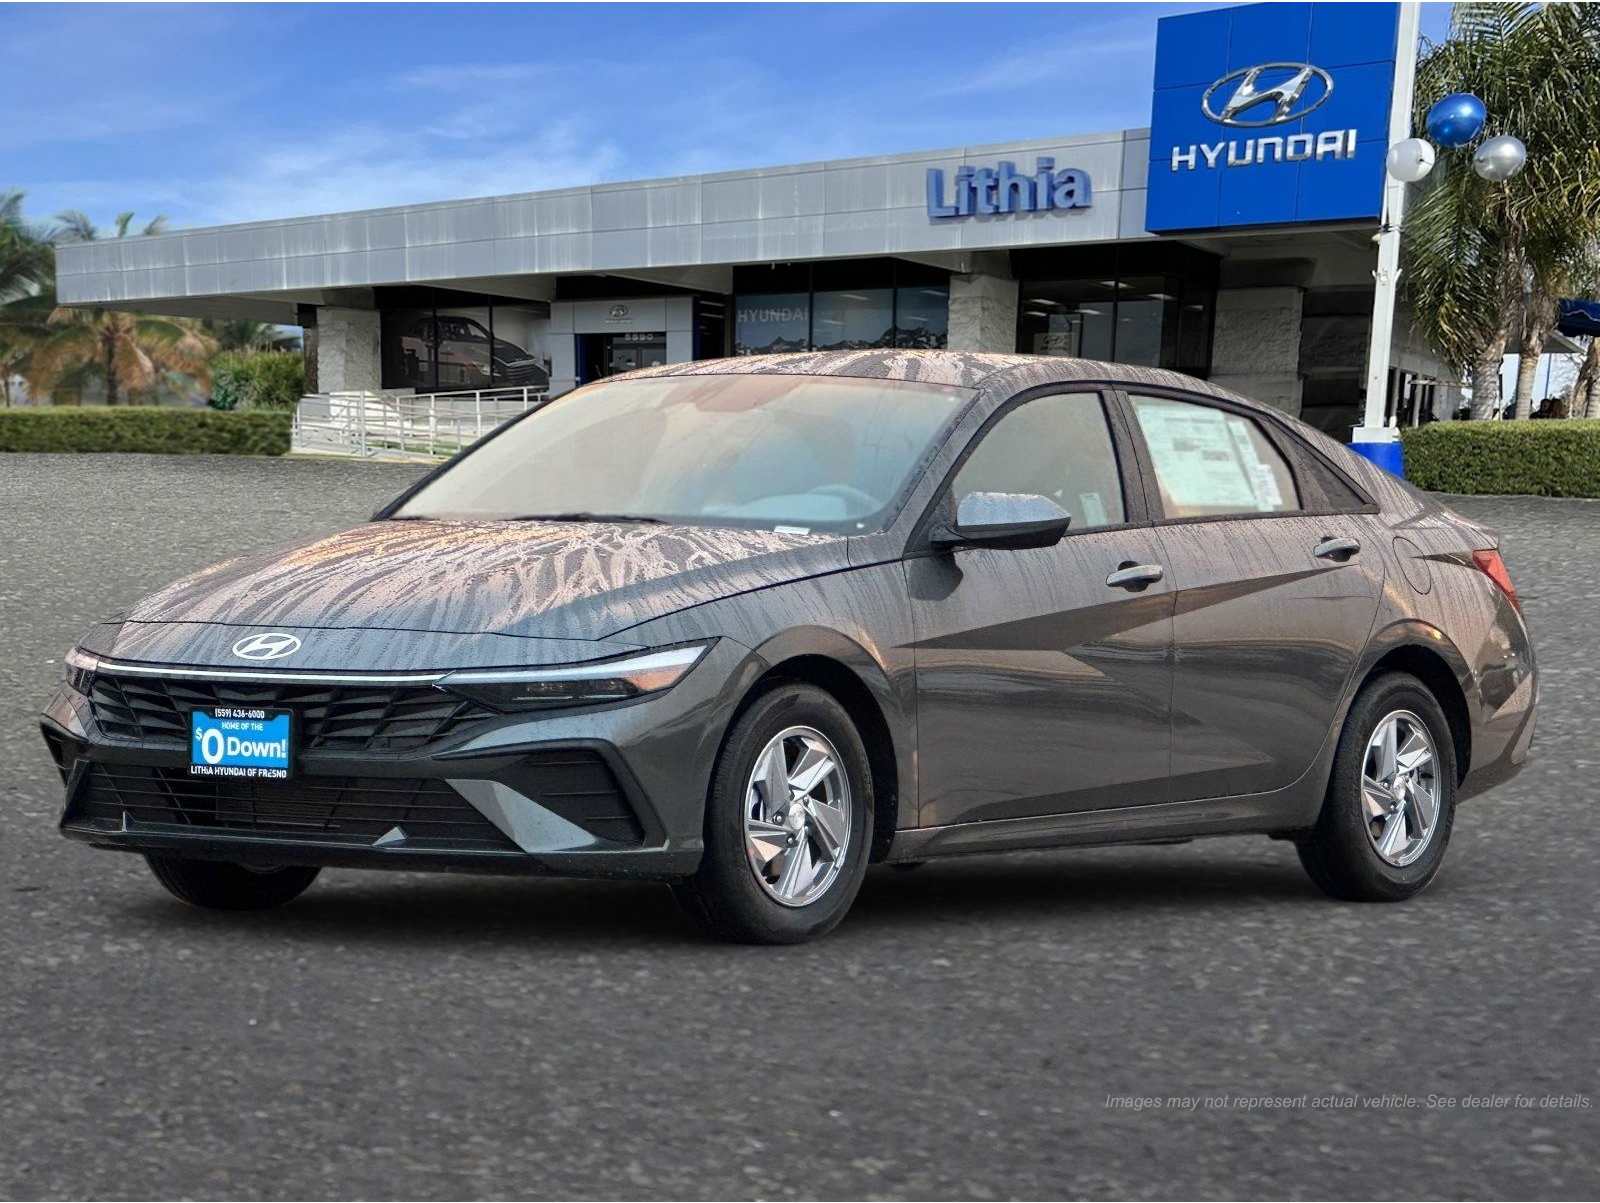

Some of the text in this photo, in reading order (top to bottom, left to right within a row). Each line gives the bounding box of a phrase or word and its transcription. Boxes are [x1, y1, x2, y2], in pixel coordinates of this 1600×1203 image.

[1171, 128, 1358, 172] HYUNDAI
[926, 156, 1093, 219] Lithia
[736, 307, 809, 323] HYUNDAI
[214, 708, 265, 719] (559) 436-6000
[221, 721, 264, 731] HOME OF THE
[226, 736, 287, 758] Down!
[190, 765, 287, 779] LITHIA HYUNDAI OF FRESNO
